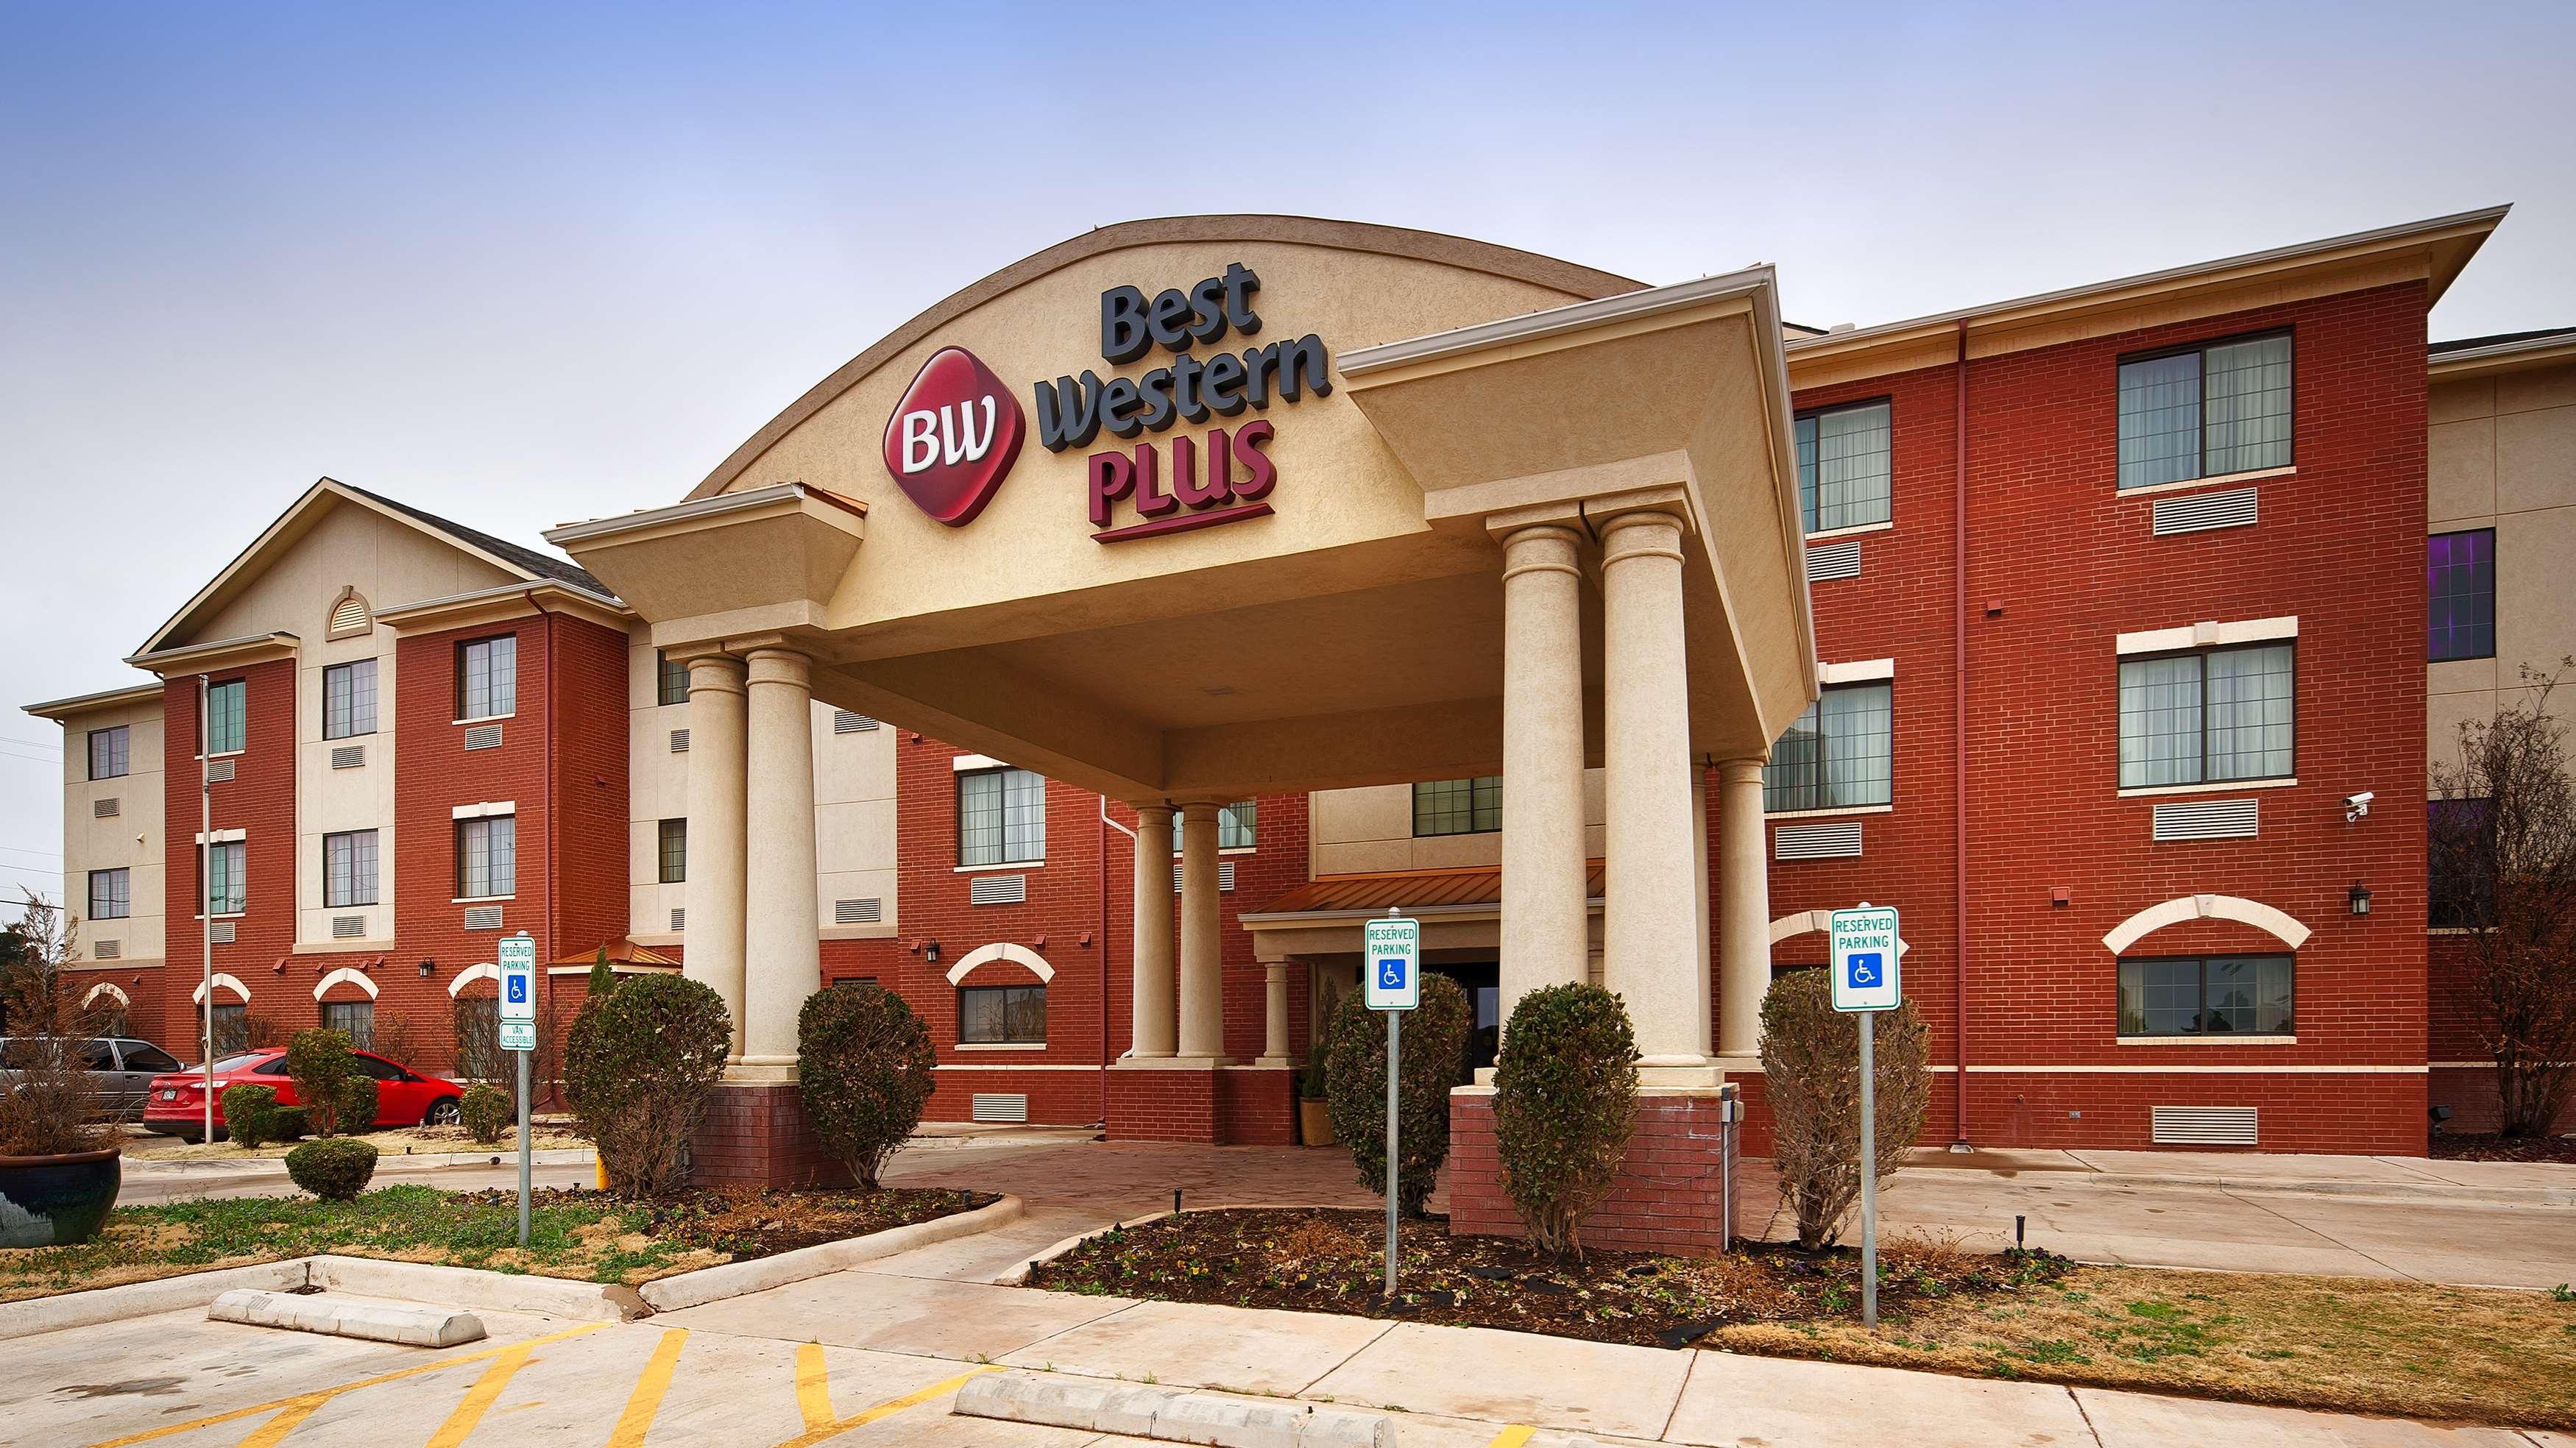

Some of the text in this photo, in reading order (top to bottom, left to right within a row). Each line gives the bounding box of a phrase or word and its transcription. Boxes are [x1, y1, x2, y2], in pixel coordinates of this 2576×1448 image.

[1101, 262, 1262, 365] Best
[1034, 333, 1333, 453] Western
[902, 394, 996, 475] BW
[1089, 419, 1277, 527] PLUS
[1836, 918, 1893, 933] RESERVED
[1370, 929, 1414, 940] RESERVED
[1839, 935, 1889, 949] PARKING
[501, 946, 532, 957] RESERVED
[1372, 944, 1411, 955] PARKING
[503, 961, 530, 971] PARKING
[512, 1026, 523, 1034] VAN
[503, 1035, 533, 1044] ACCESSIBLE
